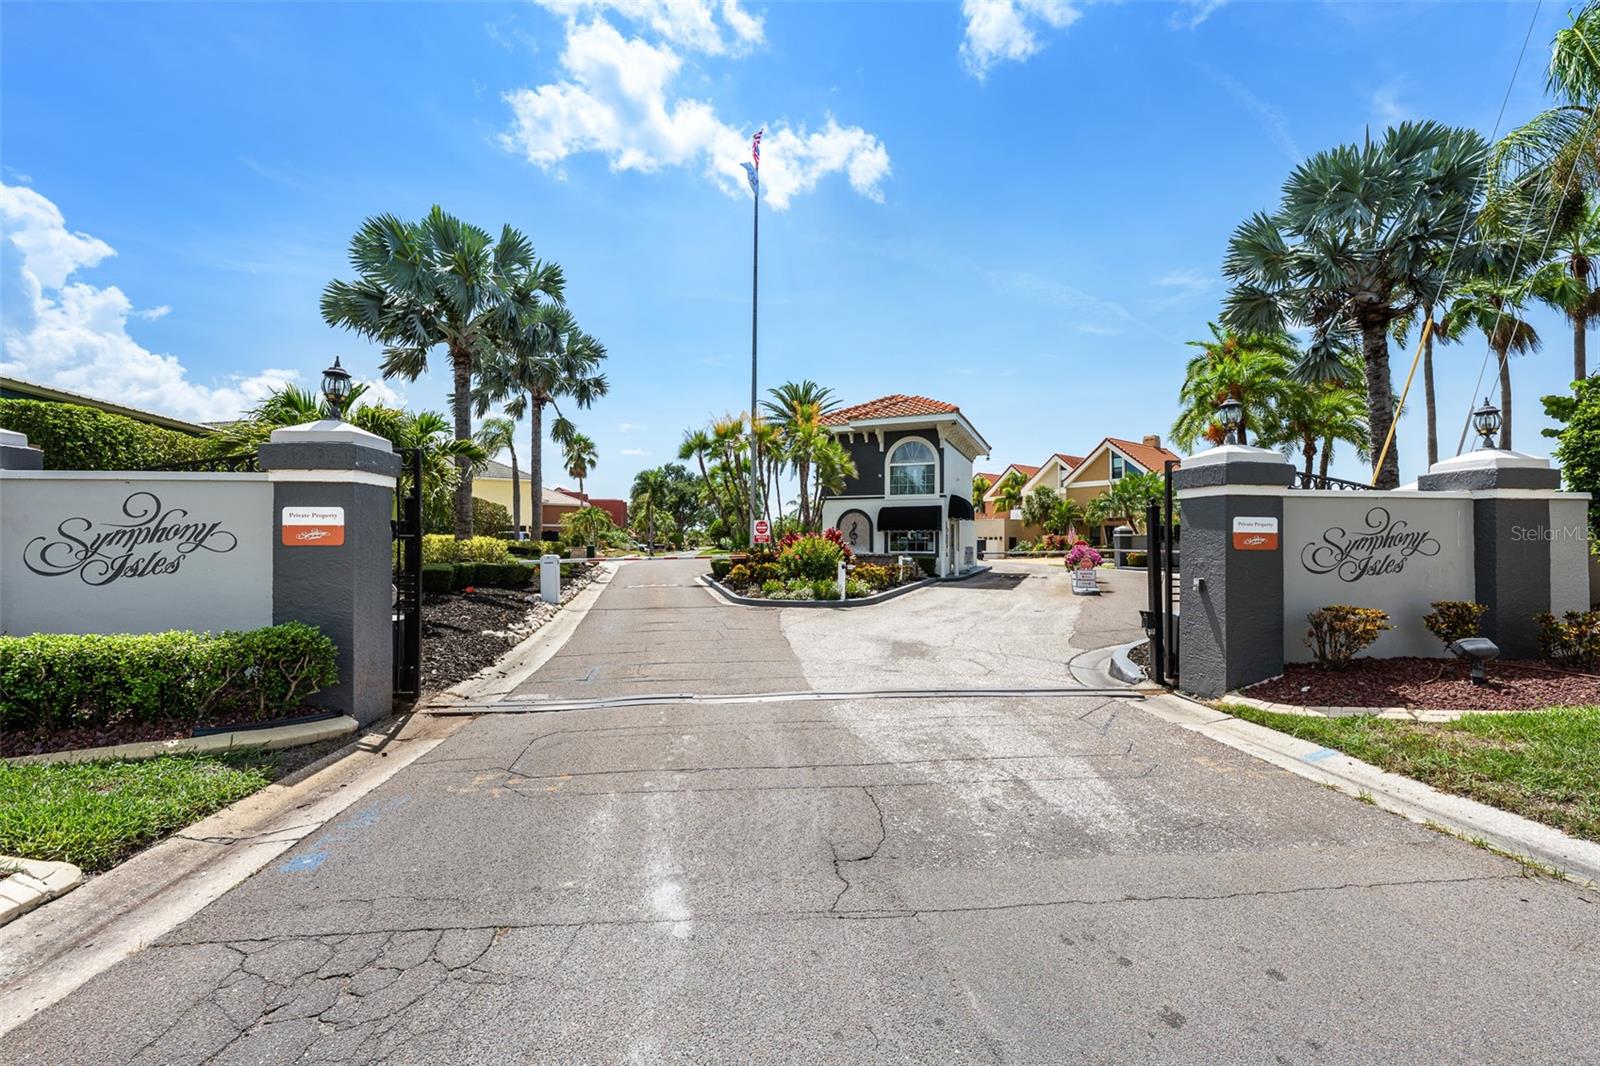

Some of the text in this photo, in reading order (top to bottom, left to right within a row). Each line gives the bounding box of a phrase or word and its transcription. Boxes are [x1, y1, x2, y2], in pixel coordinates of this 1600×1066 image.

[23, 491, 238, 577] Symphony
[1300, 506, 1441, 575] Symphony
[79, 550, 186, 587] Isles
[1338, 553, 1408, 583] Isles
